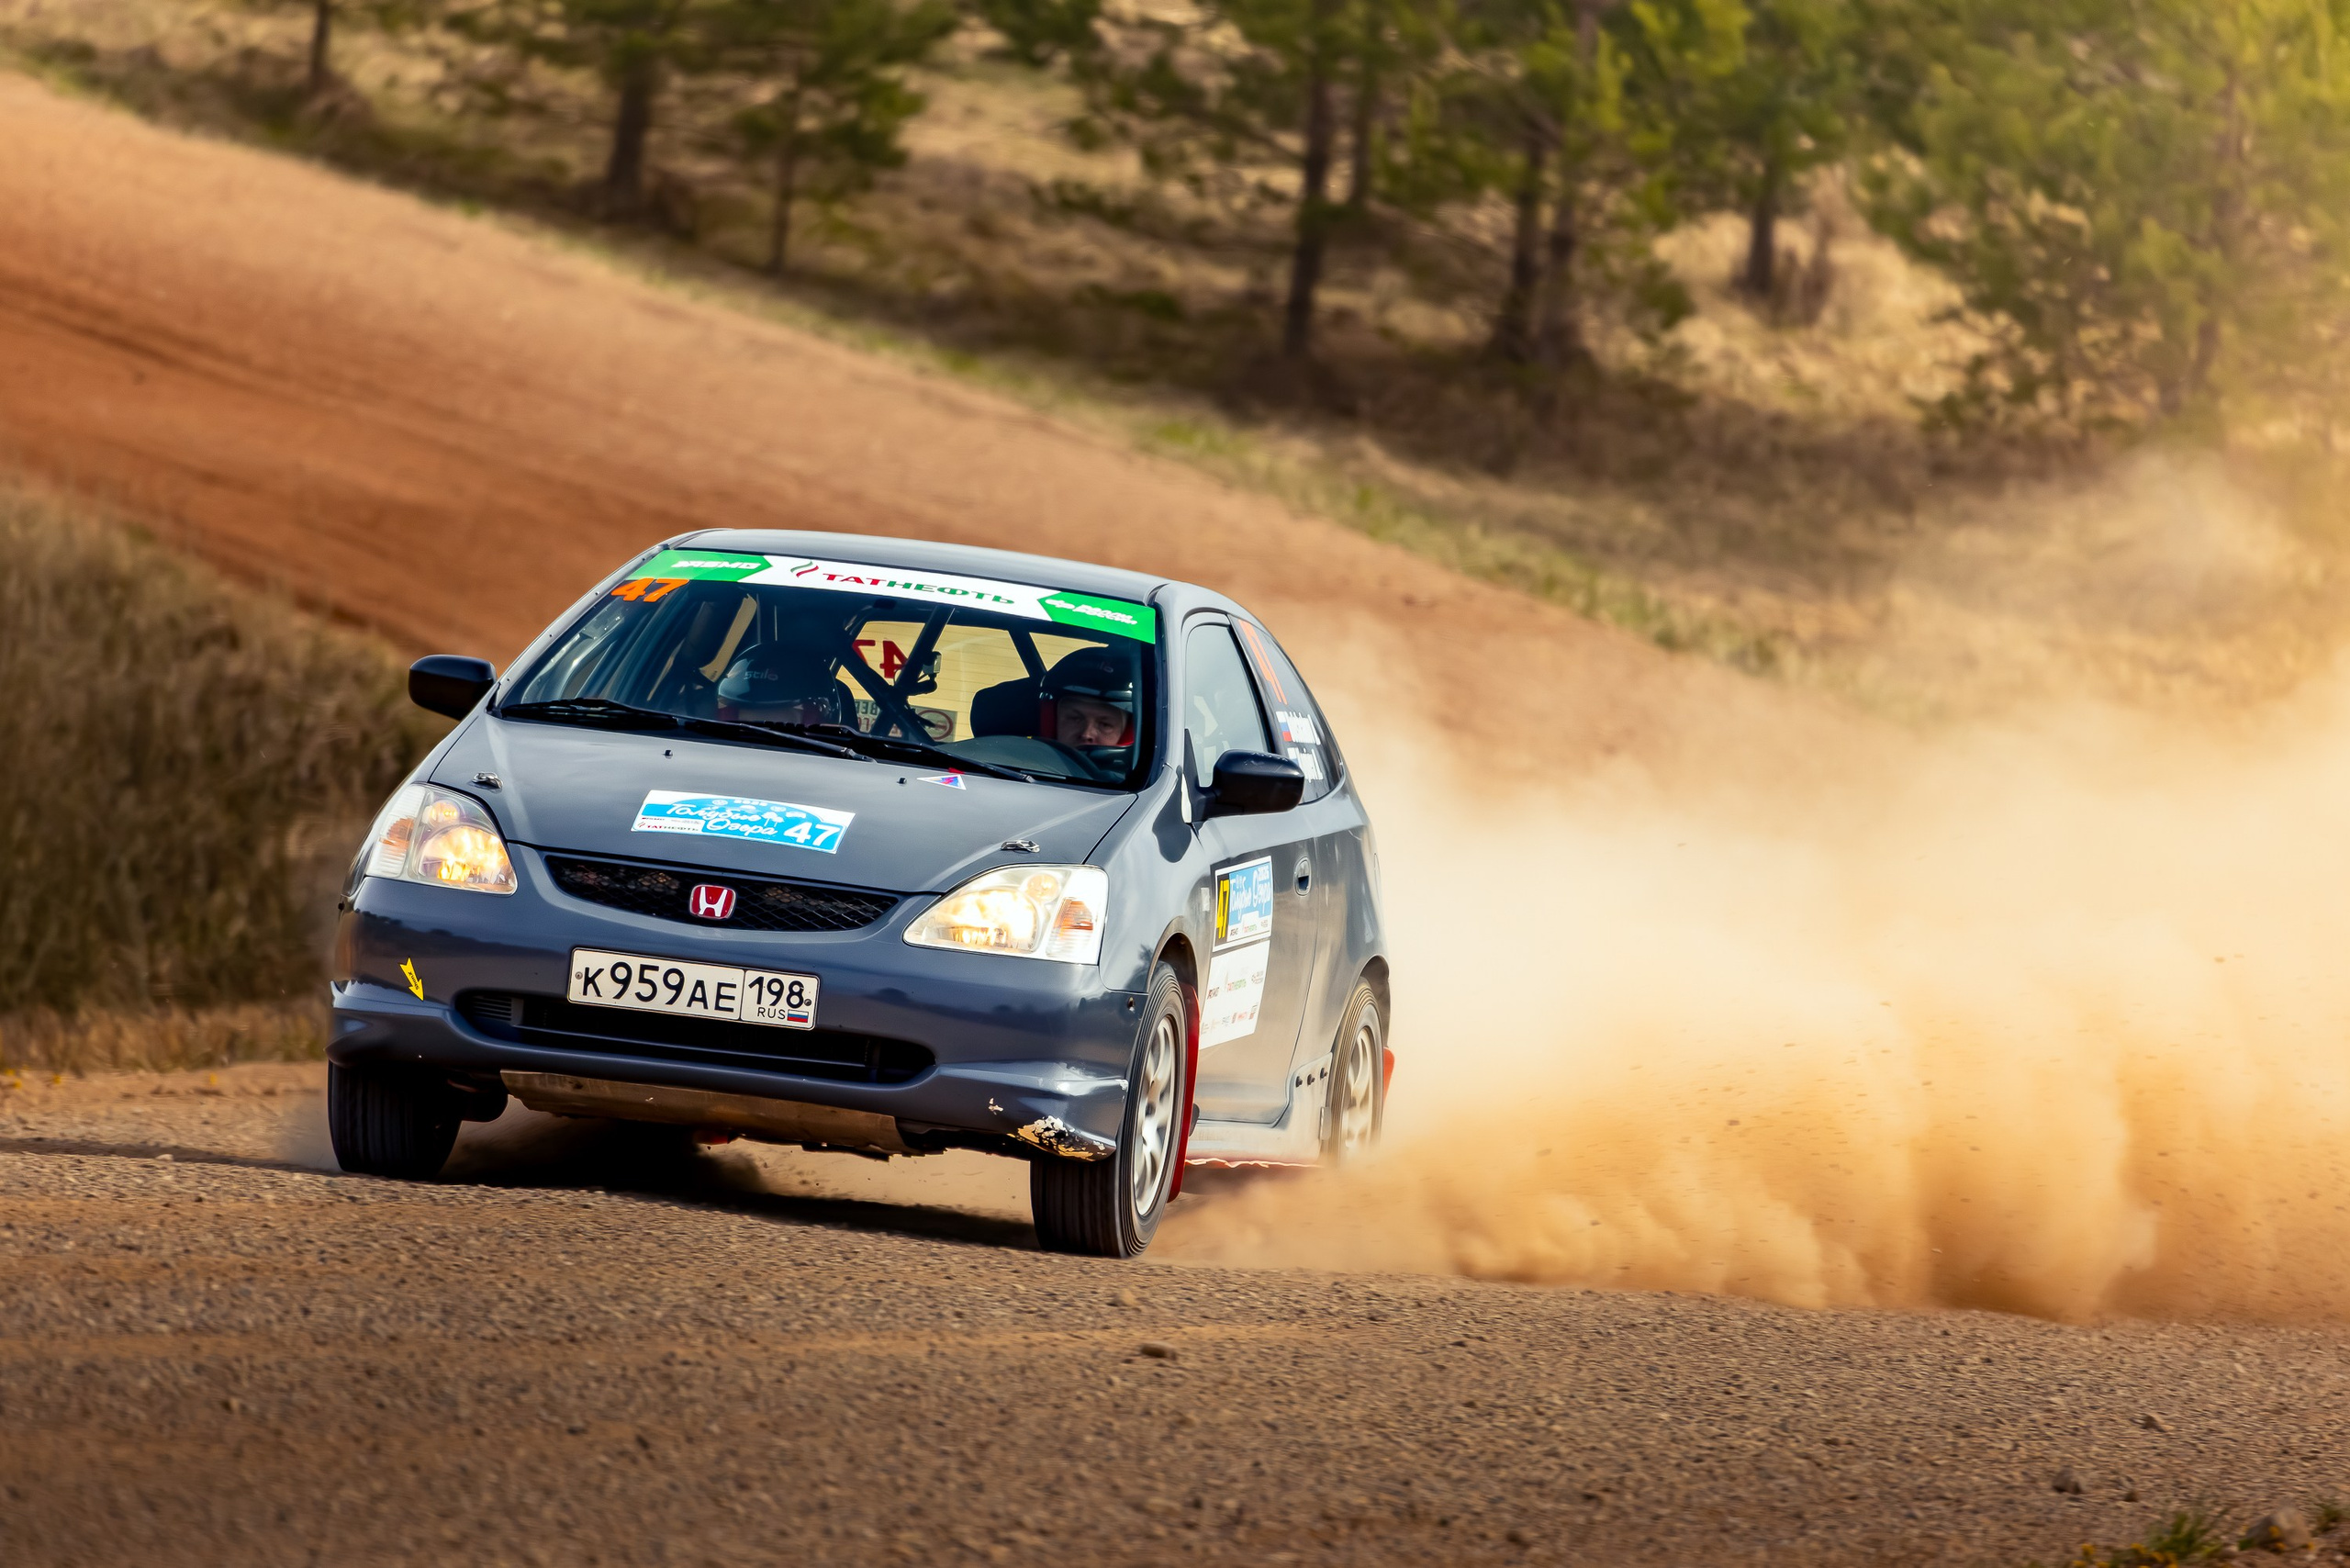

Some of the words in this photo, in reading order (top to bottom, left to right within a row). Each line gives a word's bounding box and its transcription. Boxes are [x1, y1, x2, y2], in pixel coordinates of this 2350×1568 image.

[610, 577, 689, 602] 47
[822, 573, 1014, 604] ТАТНЕФТЬ
[784, 822, 841, 846] 47
[748, 975, 805, 1009] 198
[757, 1006, 786, 1020] RUS
